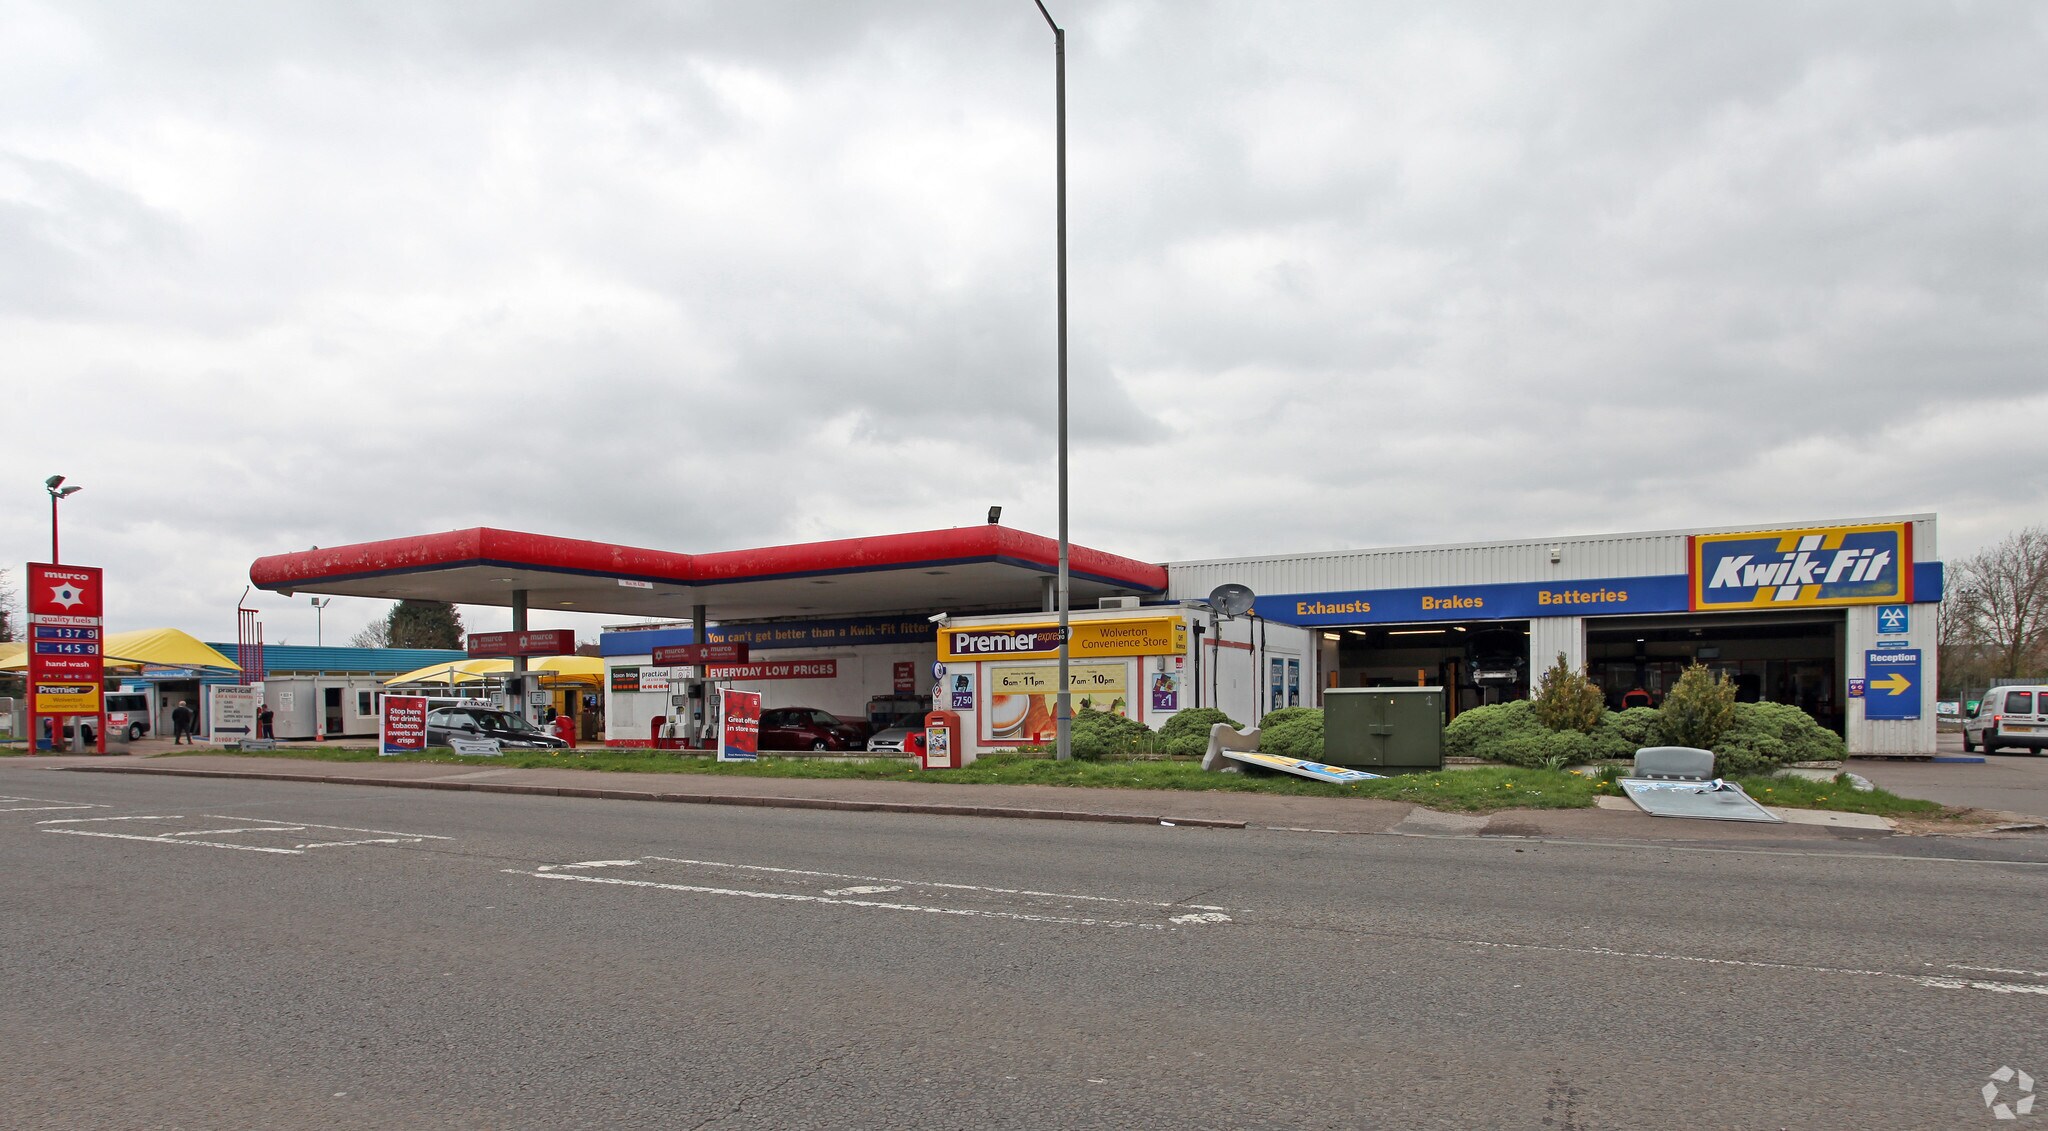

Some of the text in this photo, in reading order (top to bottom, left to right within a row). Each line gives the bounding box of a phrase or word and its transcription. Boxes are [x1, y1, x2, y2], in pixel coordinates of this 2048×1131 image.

[1708, 548, 1891, 589] Kwik-Fit
[44, 571, 89, 581] murco
[1296, 588, 1628, 616] Exhausts Brakes Batteries
[41, 616, 92, 625] quality fuels
[708, 633, 725, 644] You
[728, 631, 751, 642] can't
[756, 632, 772, 642] get
[775, 628, 807, 640] better
[811, 627, 835, 638] than
[850, 623, 896, 636] Kwik-Fit
[901, 622, 930, 634] fitter
[1099, 627, 1148, 638] Wolverton
[956, 631, 1037, 653] Premier
[1081, 637, 1168, 649] Convenience Store
[1870, 653, 1916, 663] Reception
[641, 670, 669, 679] practical
[710, 664, 834, 679] EVERYDAY LOW PRICES
[1002, 677, 1018, 686] 6am
[1023, 676, 1045, 687] 11pm
[1070, 675, 1087, 685] 7am
[1092, 674, 1115, 685] 10pm
[38, 685, 80, 694] Premier
[1161, 694, 1172, 706] £1
